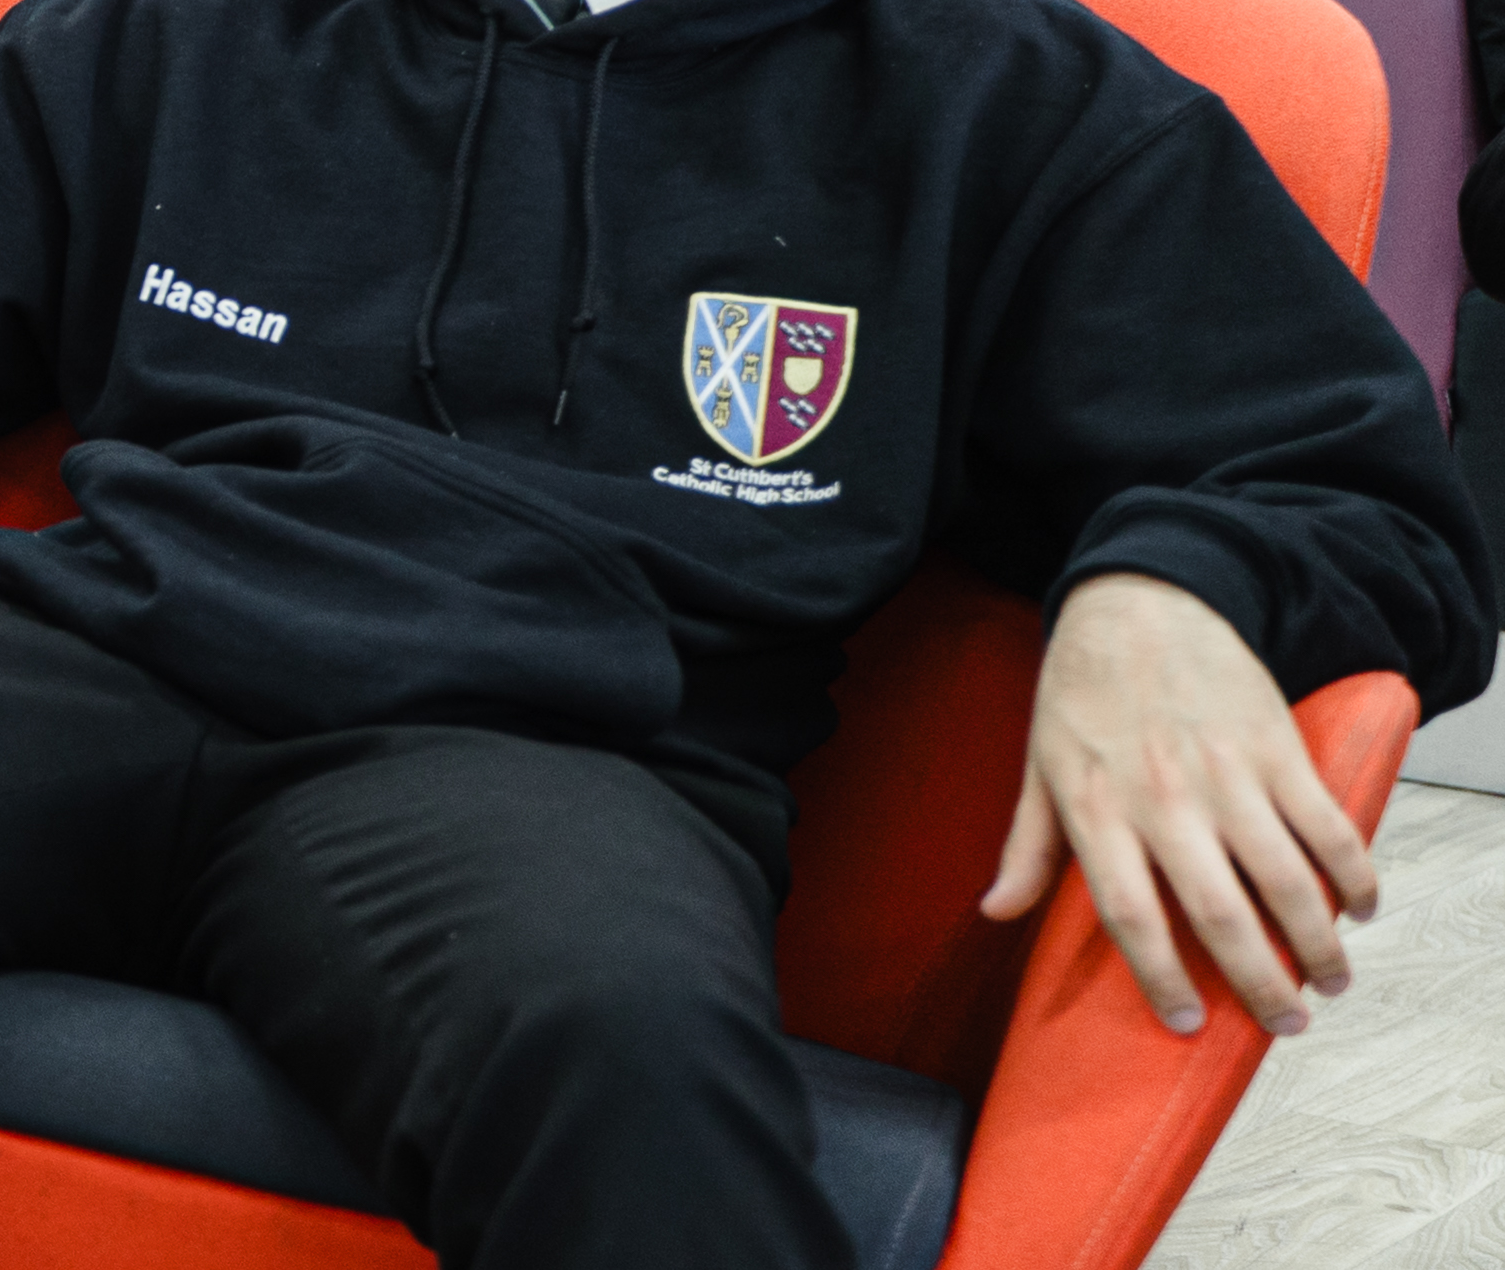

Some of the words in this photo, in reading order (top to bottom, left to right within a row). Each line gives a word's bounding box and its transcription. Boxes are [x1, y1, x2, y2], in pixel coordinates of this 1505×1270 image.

[139, 263, 288, 344] Hassan
[652, 466, 732, 497] Catholic
[736, 484, 781, 505] High
[780, 481, 840, 504] School
[691, 457, 712, 476] St
[714, 462, 814, 487] Cuthbert's
